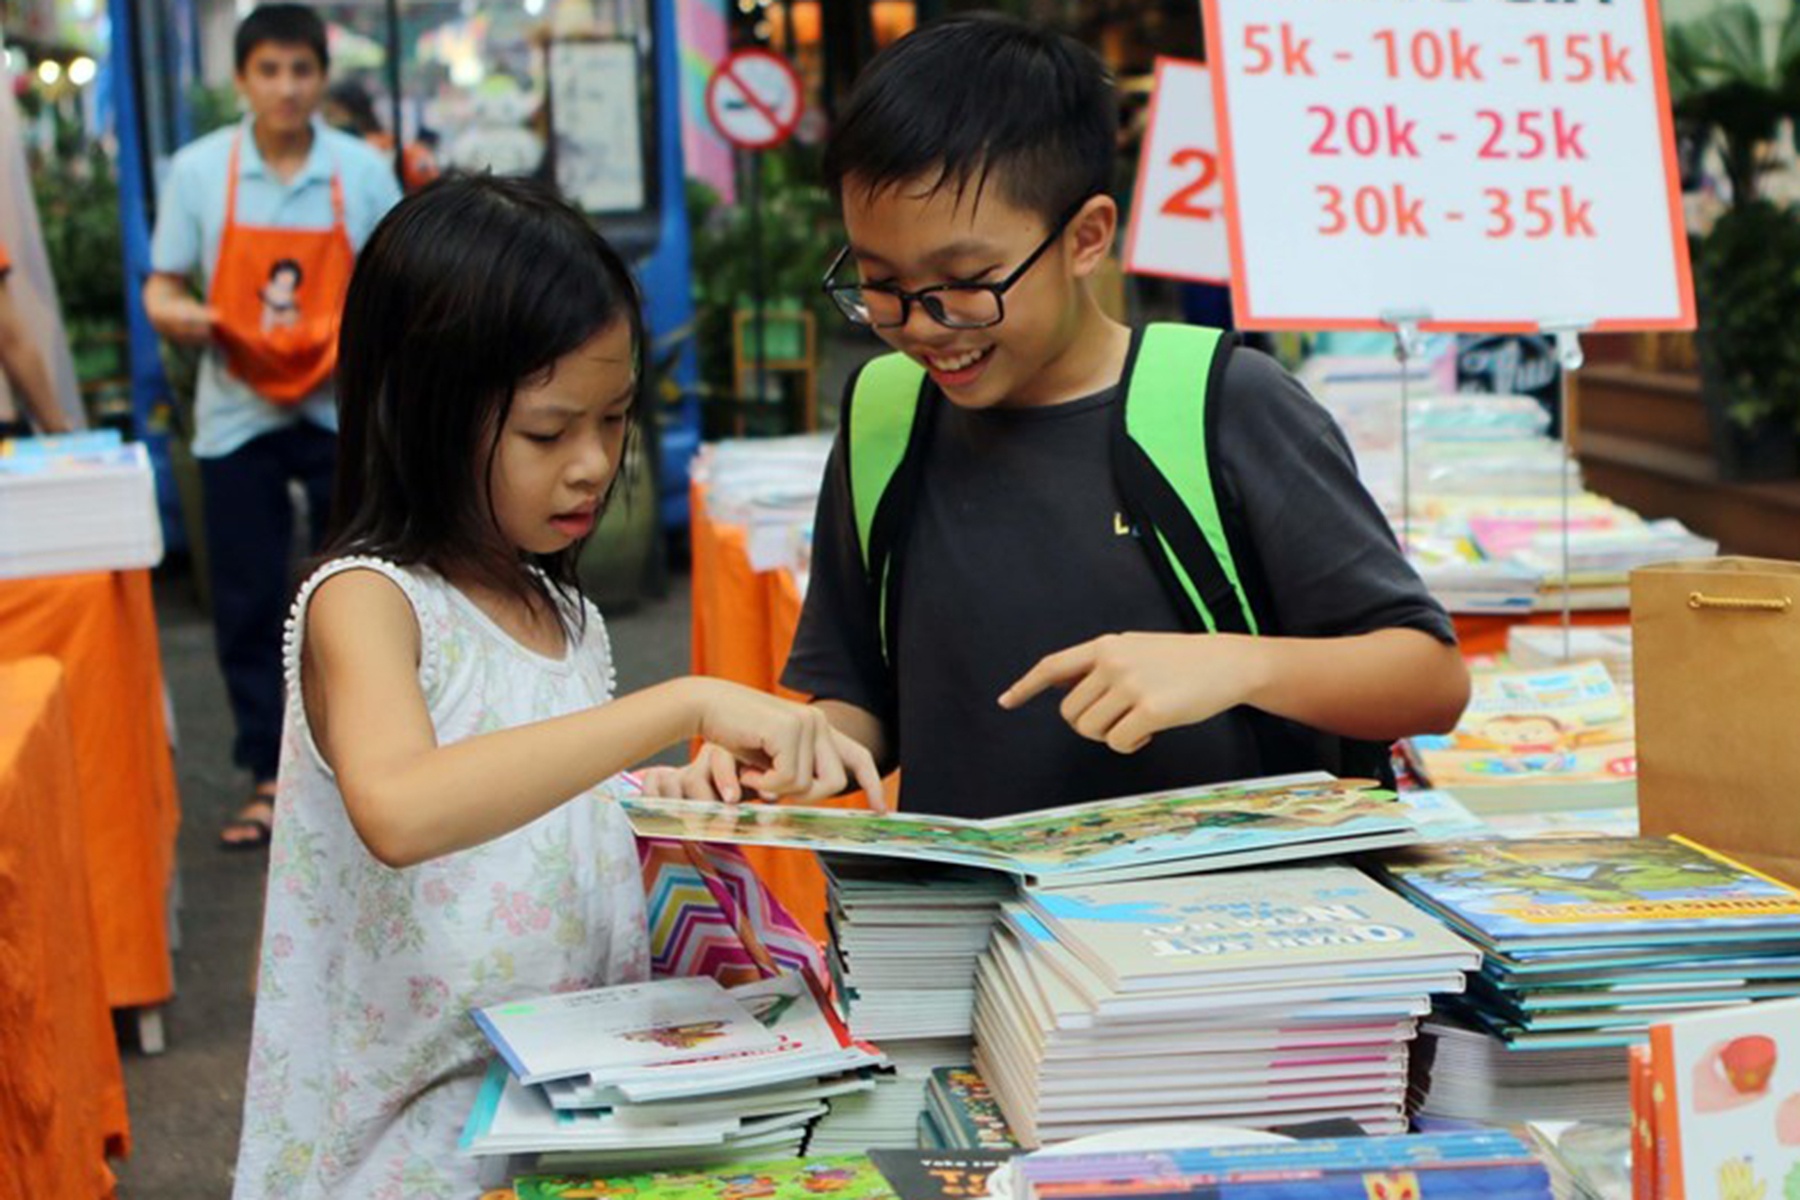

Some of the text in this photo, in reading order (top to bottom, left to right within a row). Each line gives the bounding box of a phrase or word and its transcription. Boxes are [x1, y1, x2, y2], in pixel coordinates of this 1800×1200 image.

[1243, 21, 1316, 77] 5k
[1372, 27, 1485, 81] 10k
[1305, 103, 1419, 159] 20k
[1476, 107, 1588, 162] 25k
[1317, 184, 1427, 237] 30k
[1483, 184, 1596, 240] 35k
